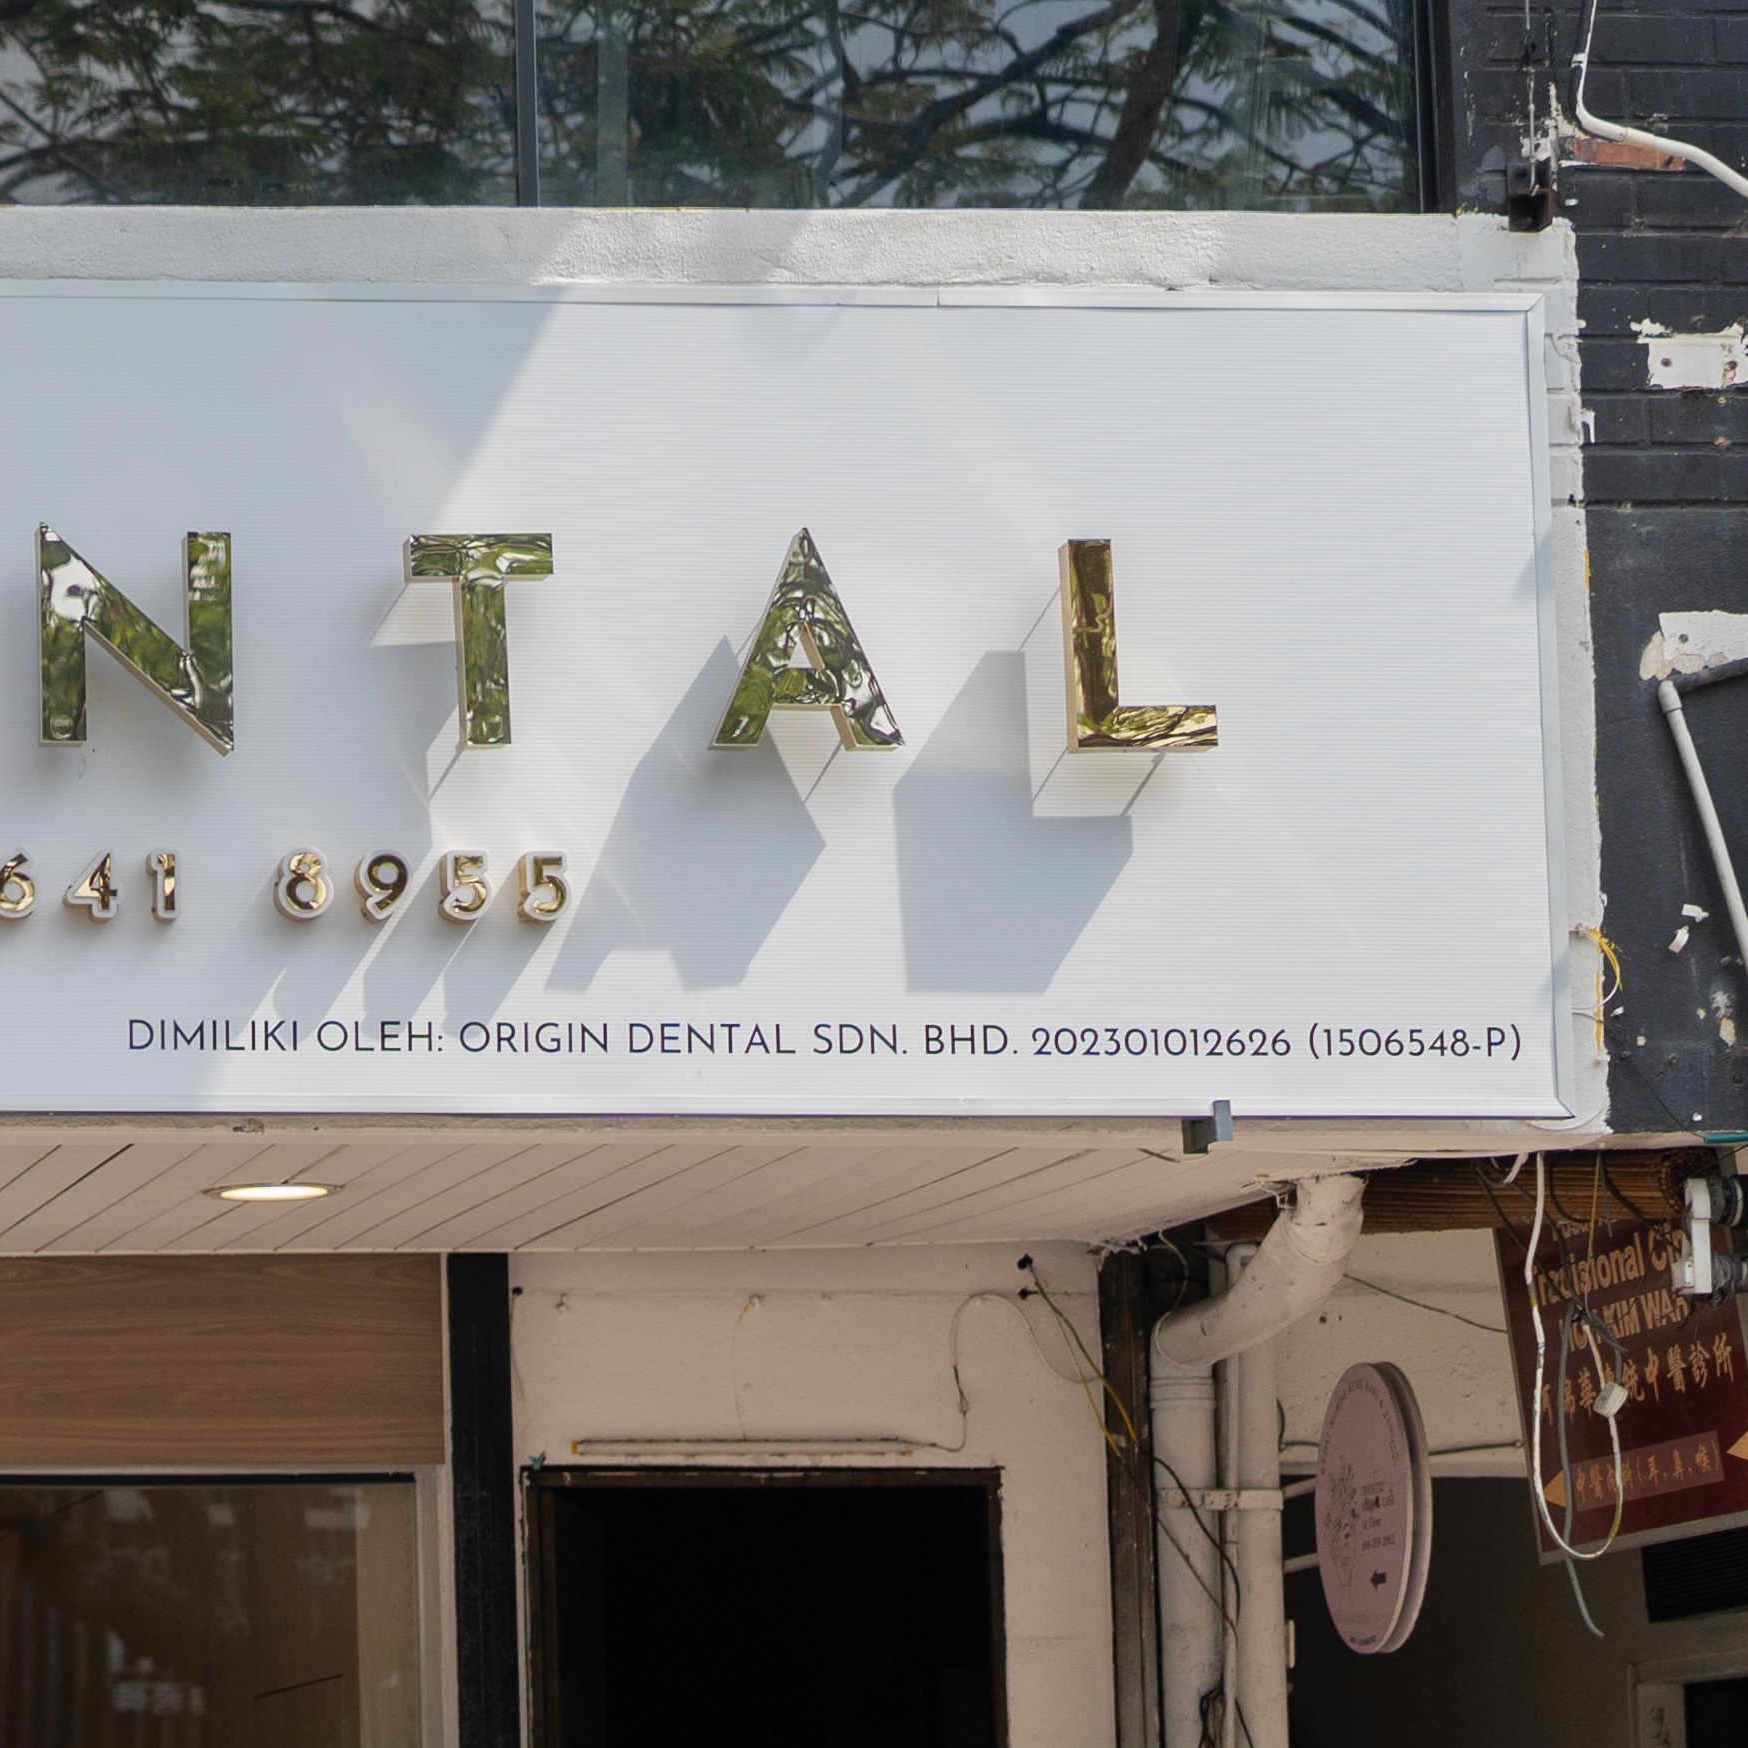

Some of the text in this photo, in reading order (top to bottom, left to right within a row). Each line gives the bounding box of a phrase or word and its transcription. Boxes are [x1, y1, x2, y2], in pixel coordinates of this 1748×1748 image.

[271, 846, 575, 922] 8955
[127, 1018, 1523, 1063] DIMILIKI OLEH: ORIGIN DENTAL SDN. BHD. 202301012626 (1506548-P)
